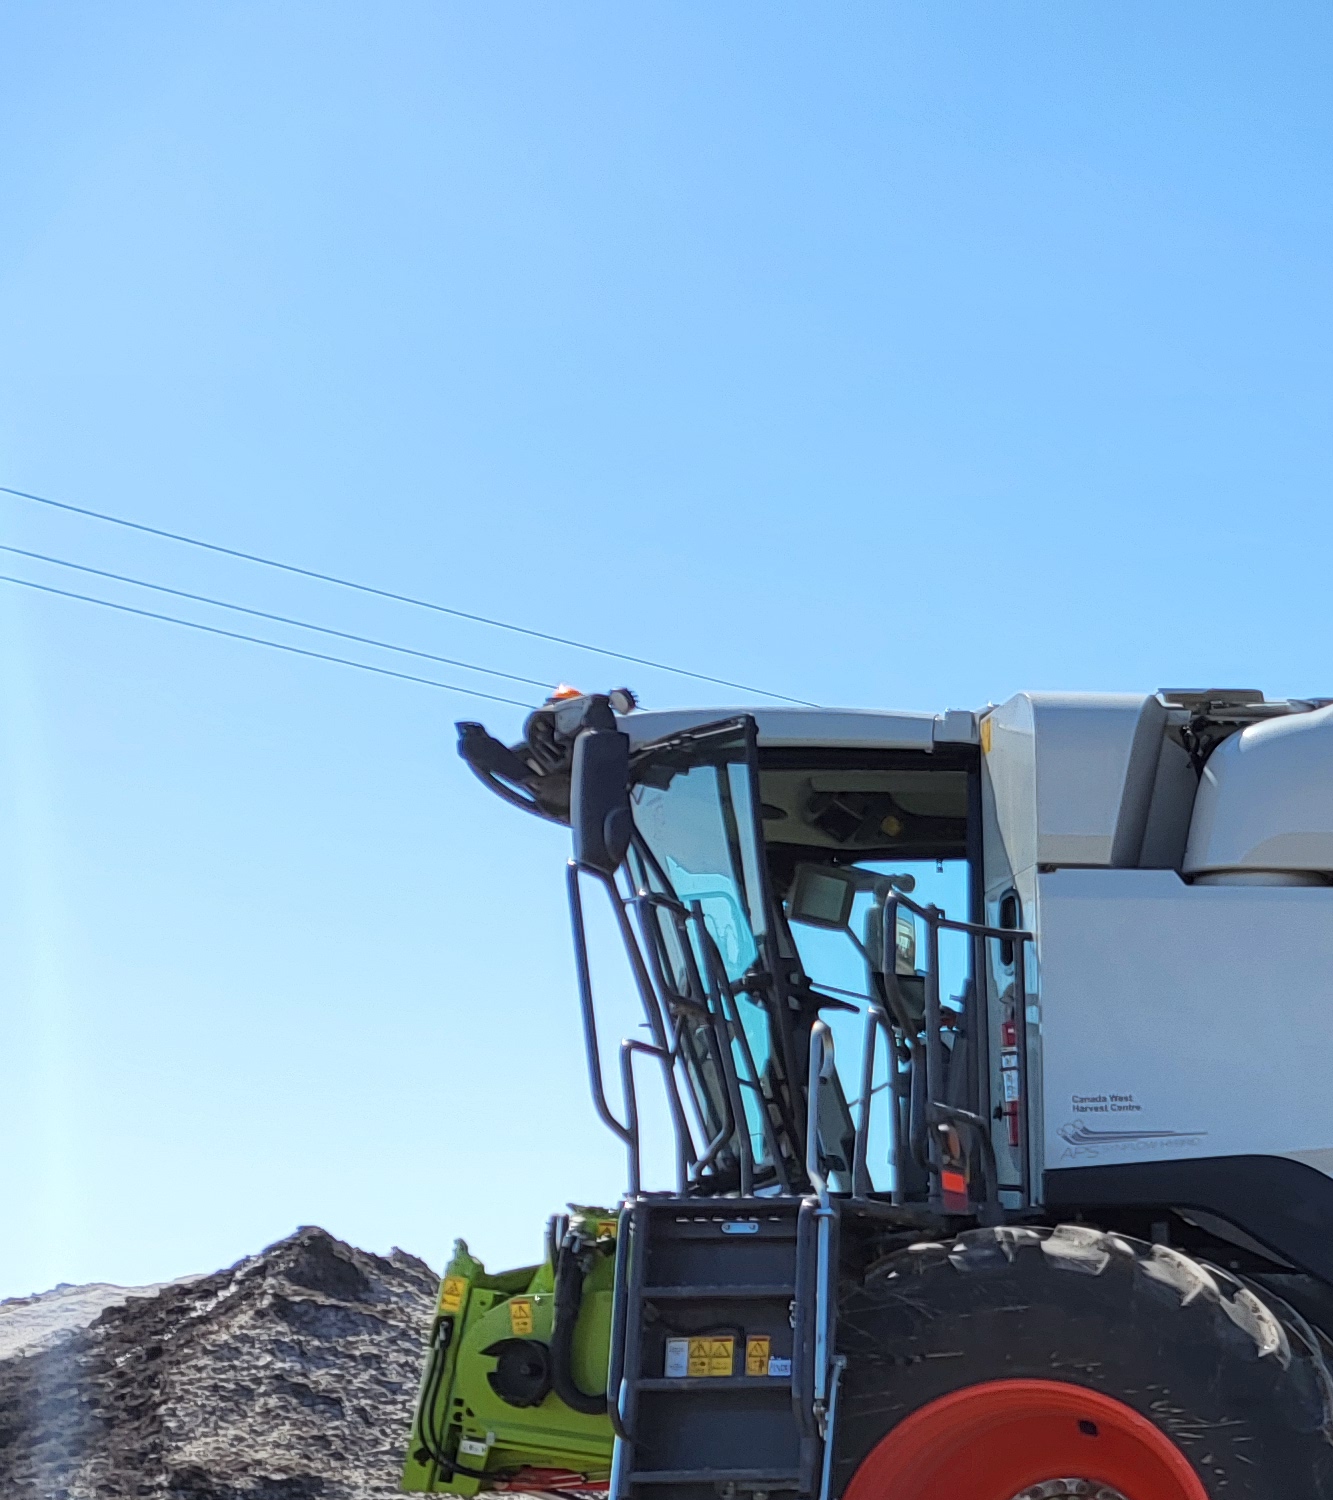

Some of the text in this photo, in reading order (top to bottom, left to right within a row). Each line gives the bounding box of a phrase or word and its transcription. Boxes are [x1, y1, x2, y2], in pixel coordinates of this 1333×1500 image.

[1071, 1094, 1134, 1104] Canada West
[1072, 1104, 1142, 1113] Harvest Centre
